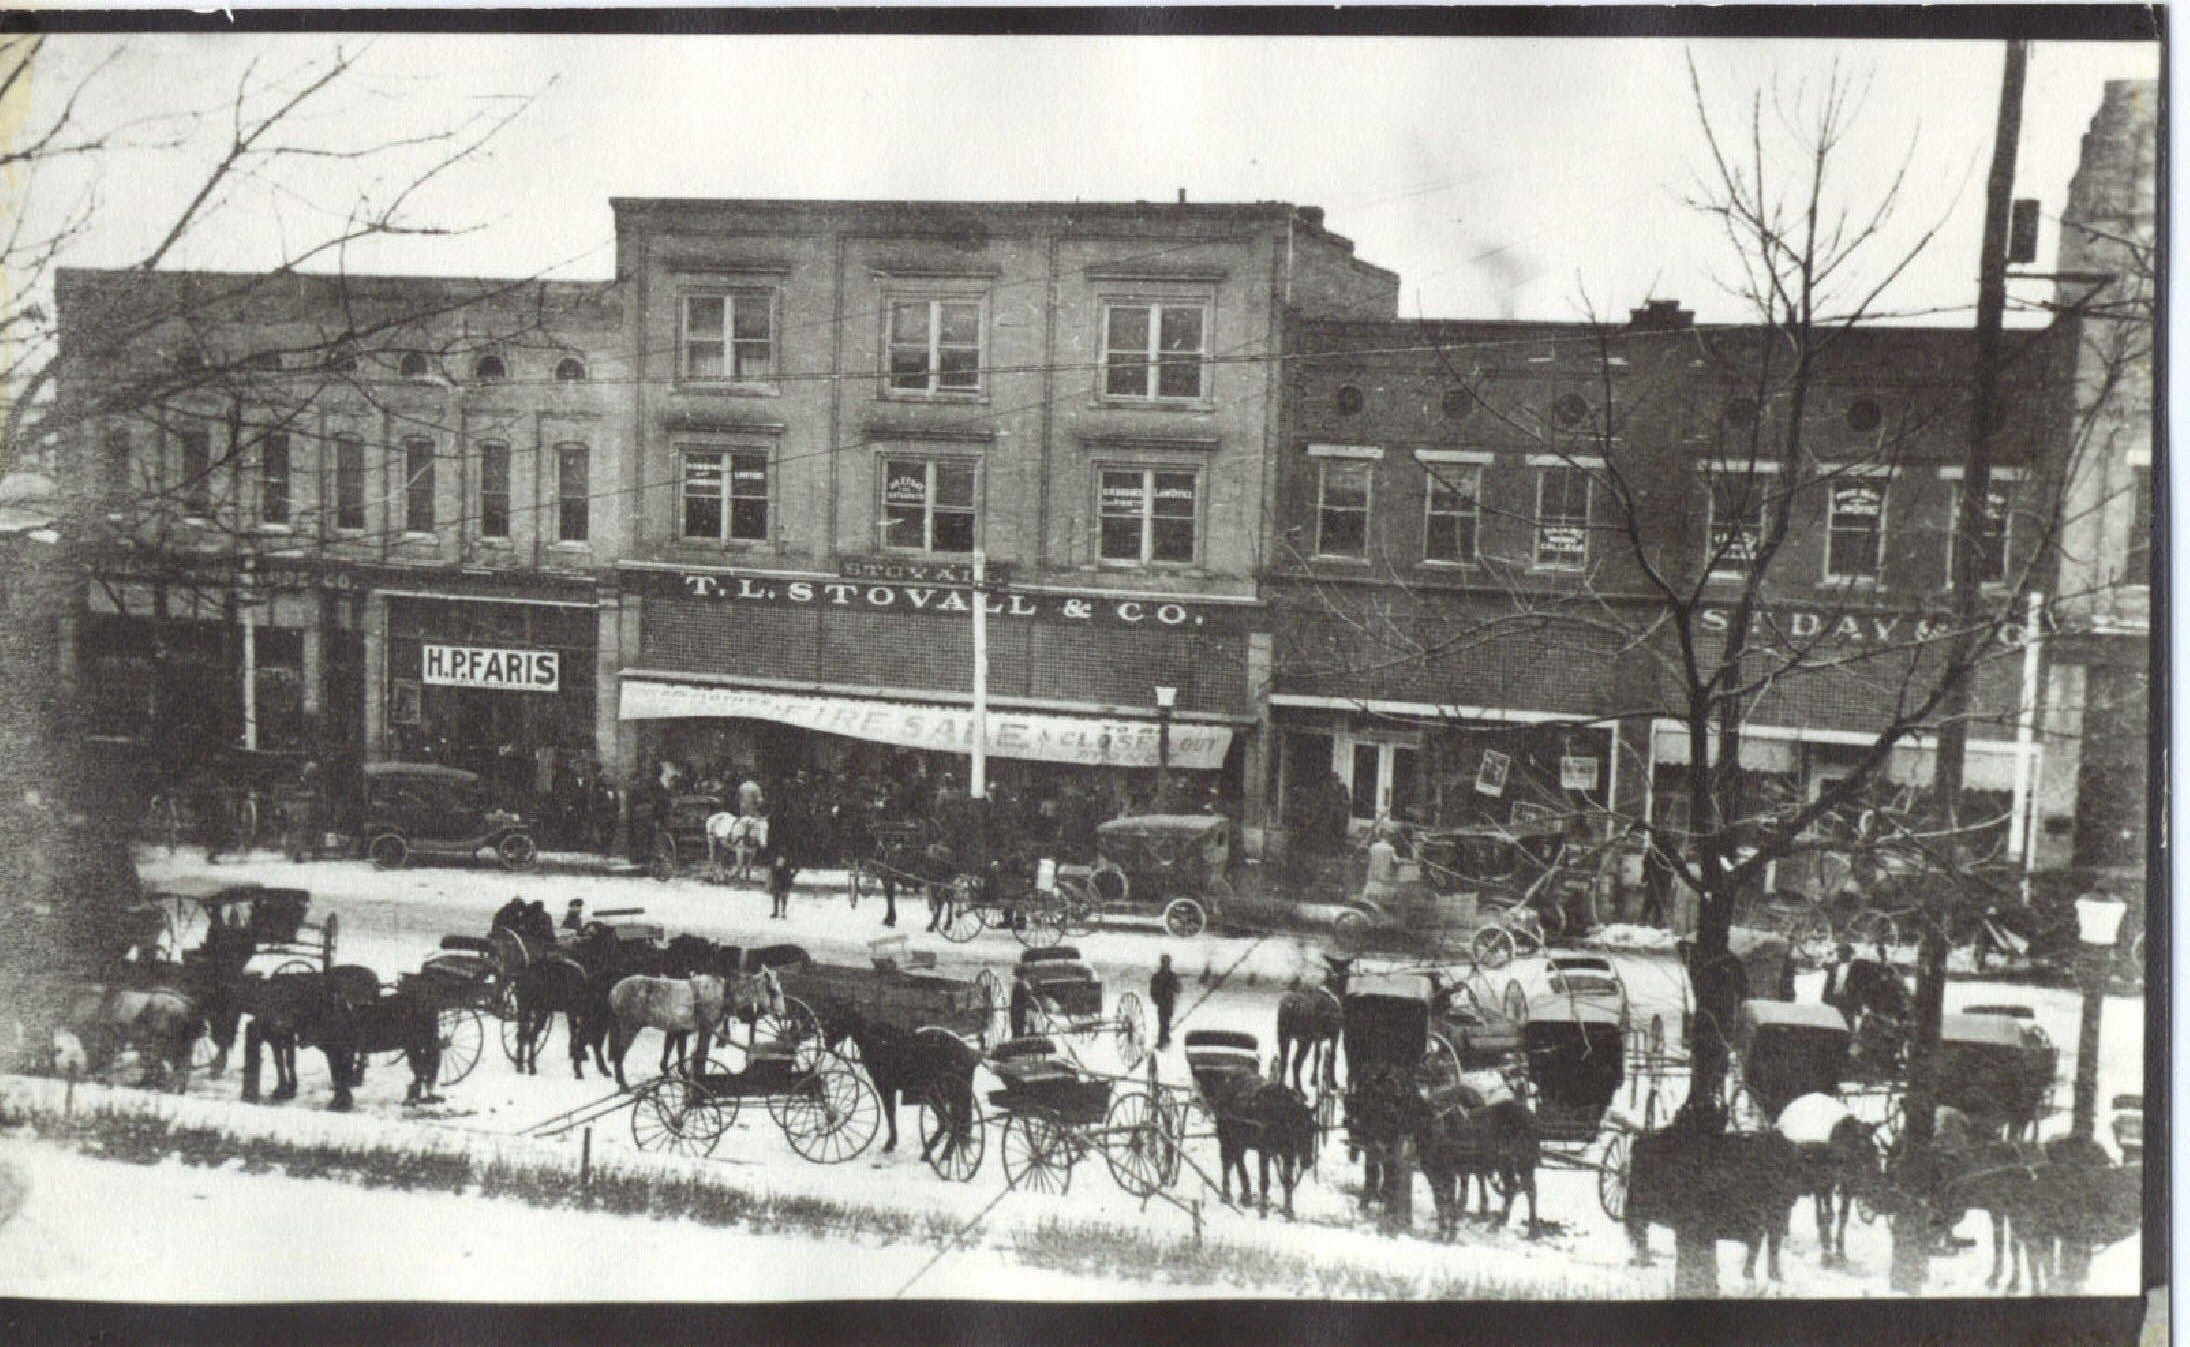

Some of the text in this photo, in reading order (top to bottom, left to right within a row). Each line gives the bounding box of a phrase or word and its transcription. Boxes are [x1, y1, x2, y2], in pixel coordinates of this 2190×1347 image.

[1063, 599, 1093, 620] &
[1117, 602, 1204, 627] CO.
[1791, 612, 1899, 642] DAY
[903, 714, 1029, 749] SALE
